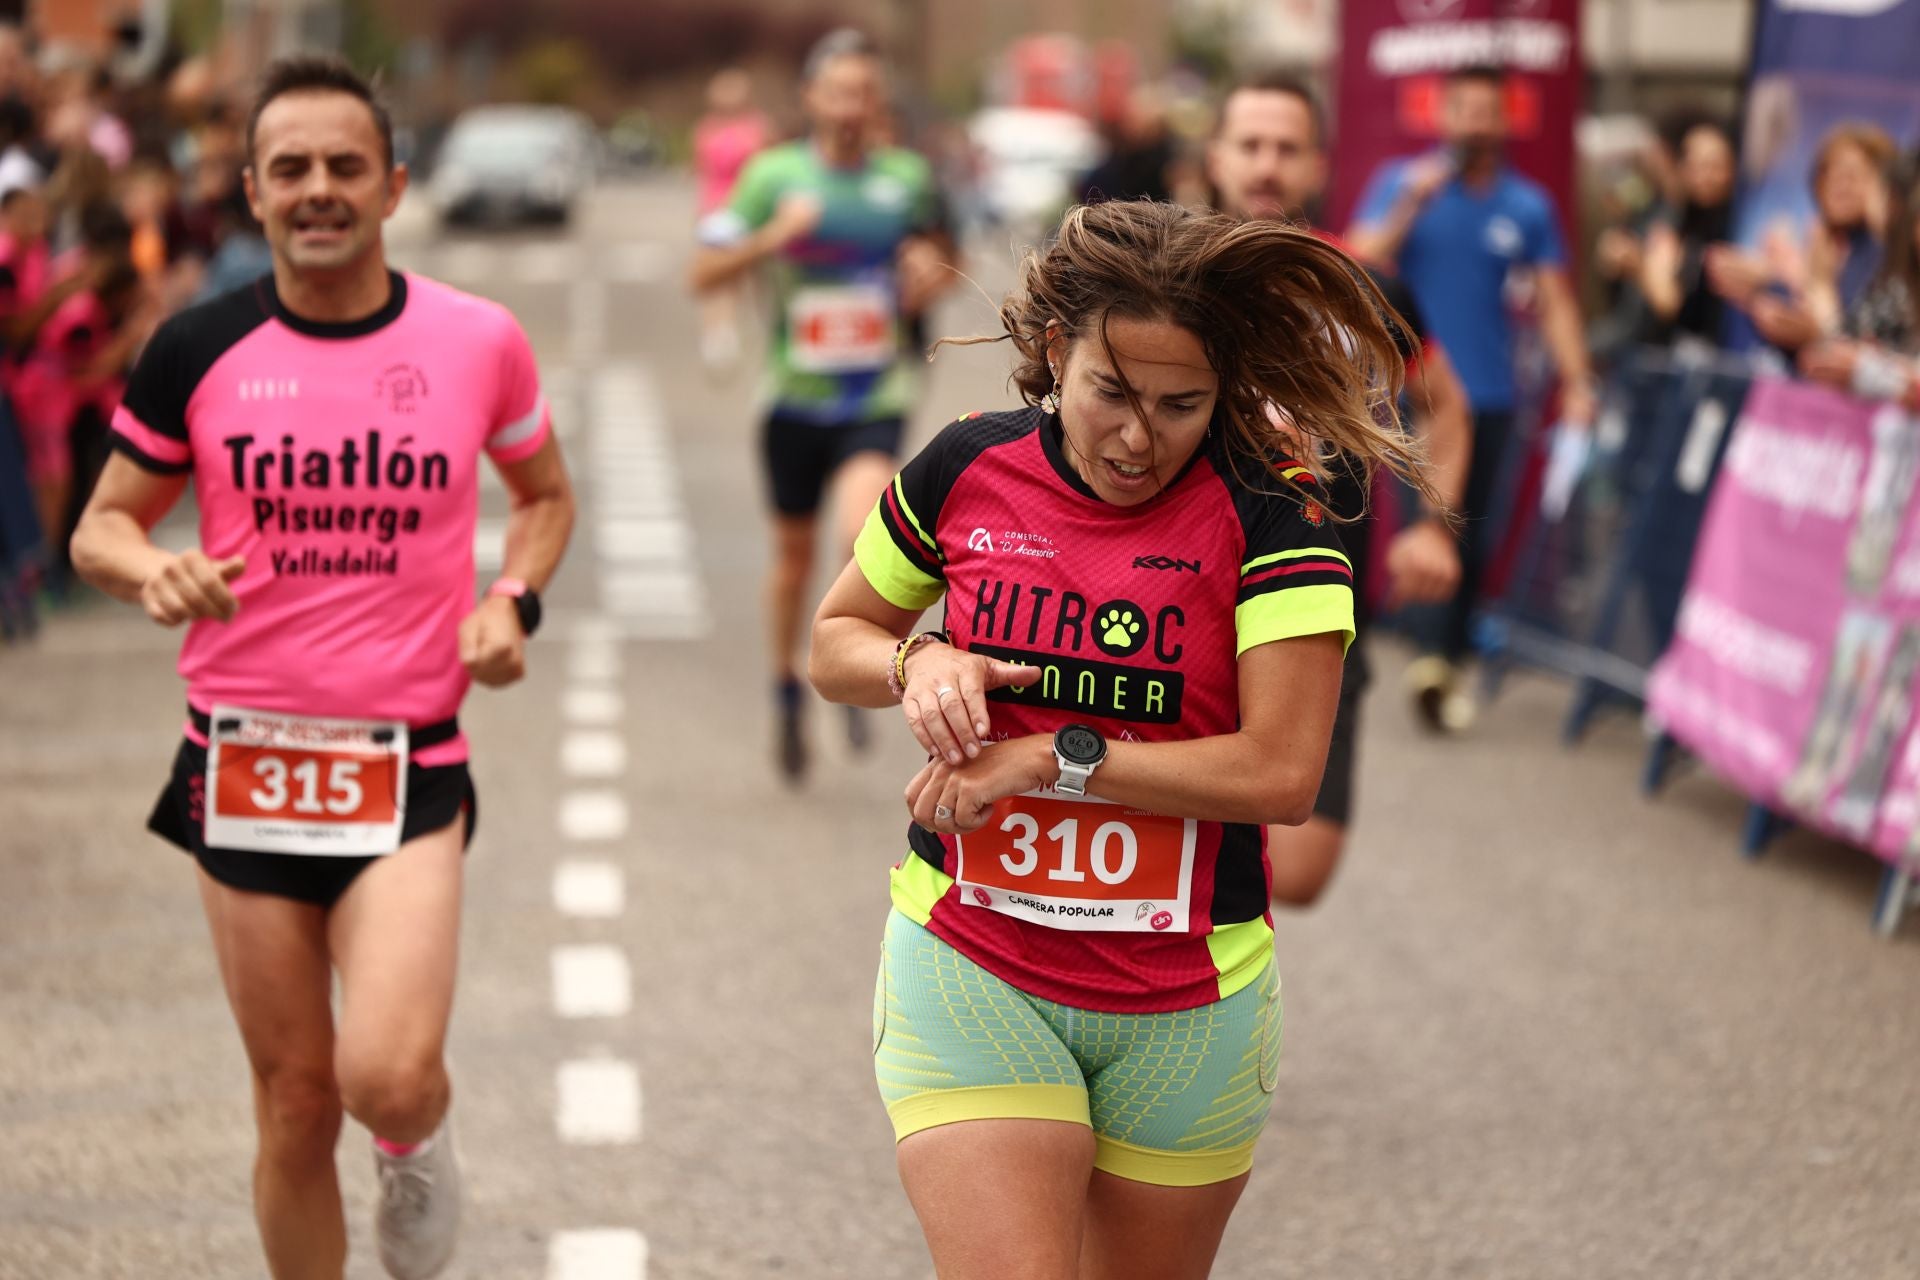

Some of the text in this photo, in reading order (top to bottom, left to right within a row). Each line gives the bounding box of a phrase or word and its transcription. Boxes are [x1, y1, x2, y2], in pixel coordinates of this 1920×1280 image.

[223, 429, 449, 491] Triatlón
[253, 497, 421, 544] Pisuerga
[1004, 530, 1054, 546] COMERCIAL
[271, 548, 398, 577] Valladolid
[1008, 658, 1165, 714] UNNER
[250, 756, 363, 815] 315
[999, 812, 1138, 885] 310
[1008, 895, 1056, 915] CARRERA
[1058, 905, 1115, 917] POPULAR
